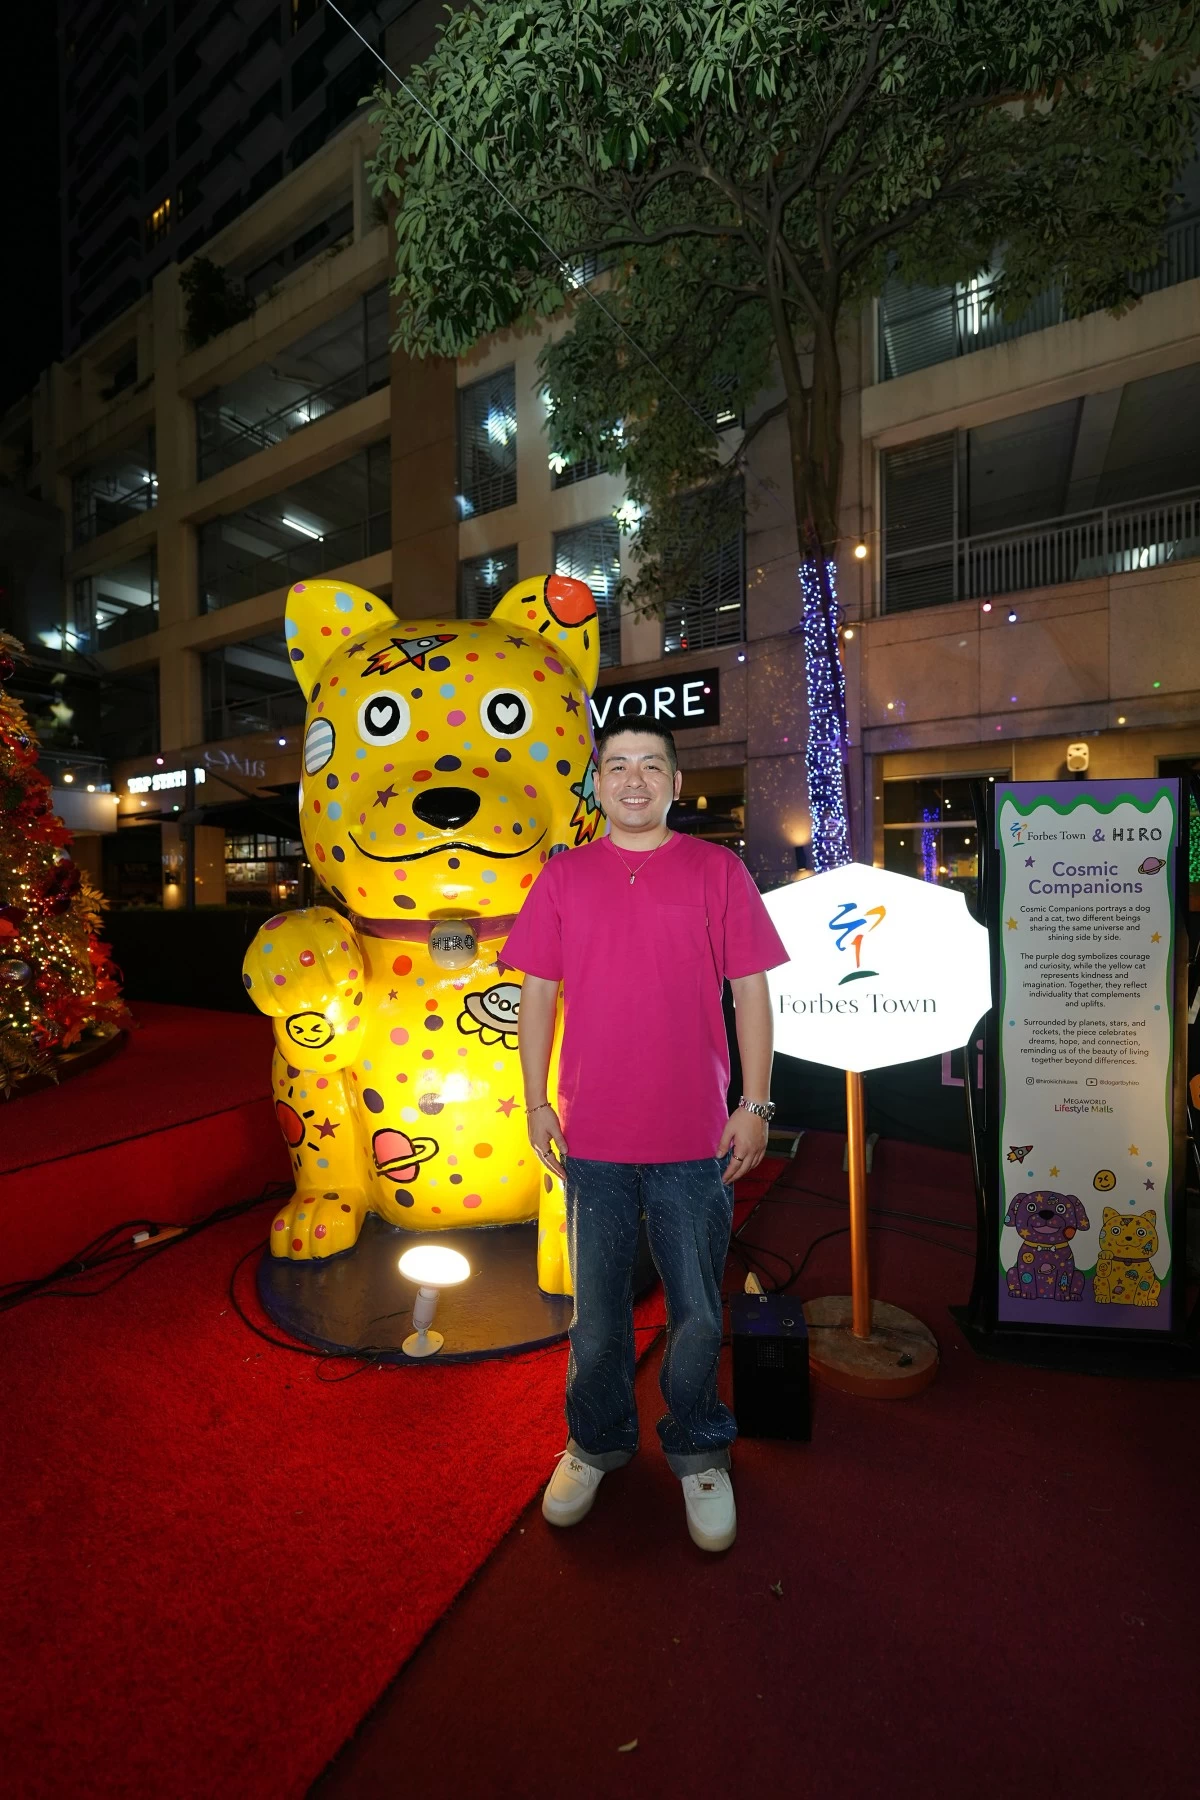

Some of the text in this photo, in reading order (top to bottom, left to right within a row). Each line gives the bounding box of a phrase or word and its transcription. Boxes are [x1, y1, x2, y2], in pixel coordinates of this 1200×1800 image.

[152, 767, 206, 791] STATIN
[1028, 827, 1162, 842] Forbes Town & HIRO
[1053, 861, 1118, 876] Cosmic
[1029, 879, 1142, 898] Companions
[1049, 905, 1094, 914] Companions
[1096, 906, 1127, 914] portrays
[1135, 904, 1150, 913] dog
[1116, 914, 1141, 923] beings
[1030, 924, 1056, 933] sharing
[1048, 934, 1073, 942] shining
[1093, 934, 1102, 942] by
[432, 935, 475, 951] HIRO
[1036, 953, 1059, 961] purple
[1061, 953, 1075, 961] dog
[1078, 953, 1117, 961] symbolizes
[1040, 963, 1071, 971] curiosity,
[1109, 962, 1132, 971] yellow
[1023, 981, 1066, 989] imagination.
[1069, 981, 1103, 990] Together,
[1105, 981, 1121, 990] they
[1029, 991, 1072, 999] individuality
[1091, 991, 1140, 999] complements
[780, 993, 937, 1014] Forbes Town
[1081, 1000, 1105, 1008] uplifts.
[1068, 1019, 1077, 1027] by
[1079, 1019, 1107, 1027] planets,
[1033, 1028, 1060, 1036] rockets,
[1077, 1029, 1096, 1037] piece
[1059, 1038, 1079, 1047] hope,
[1021, 1047, 1056, 1055] reminding
[1092, 1048, 1117, 1056] beauty
[1130, 1048, 1149, 1057] living
[1065, 1057, 1092, 1065] beyond
[1099, 1079, 1140, 1087] @dogartbyhiro
[1054, 1105, 1113, 1113] Lifestyle Malls
